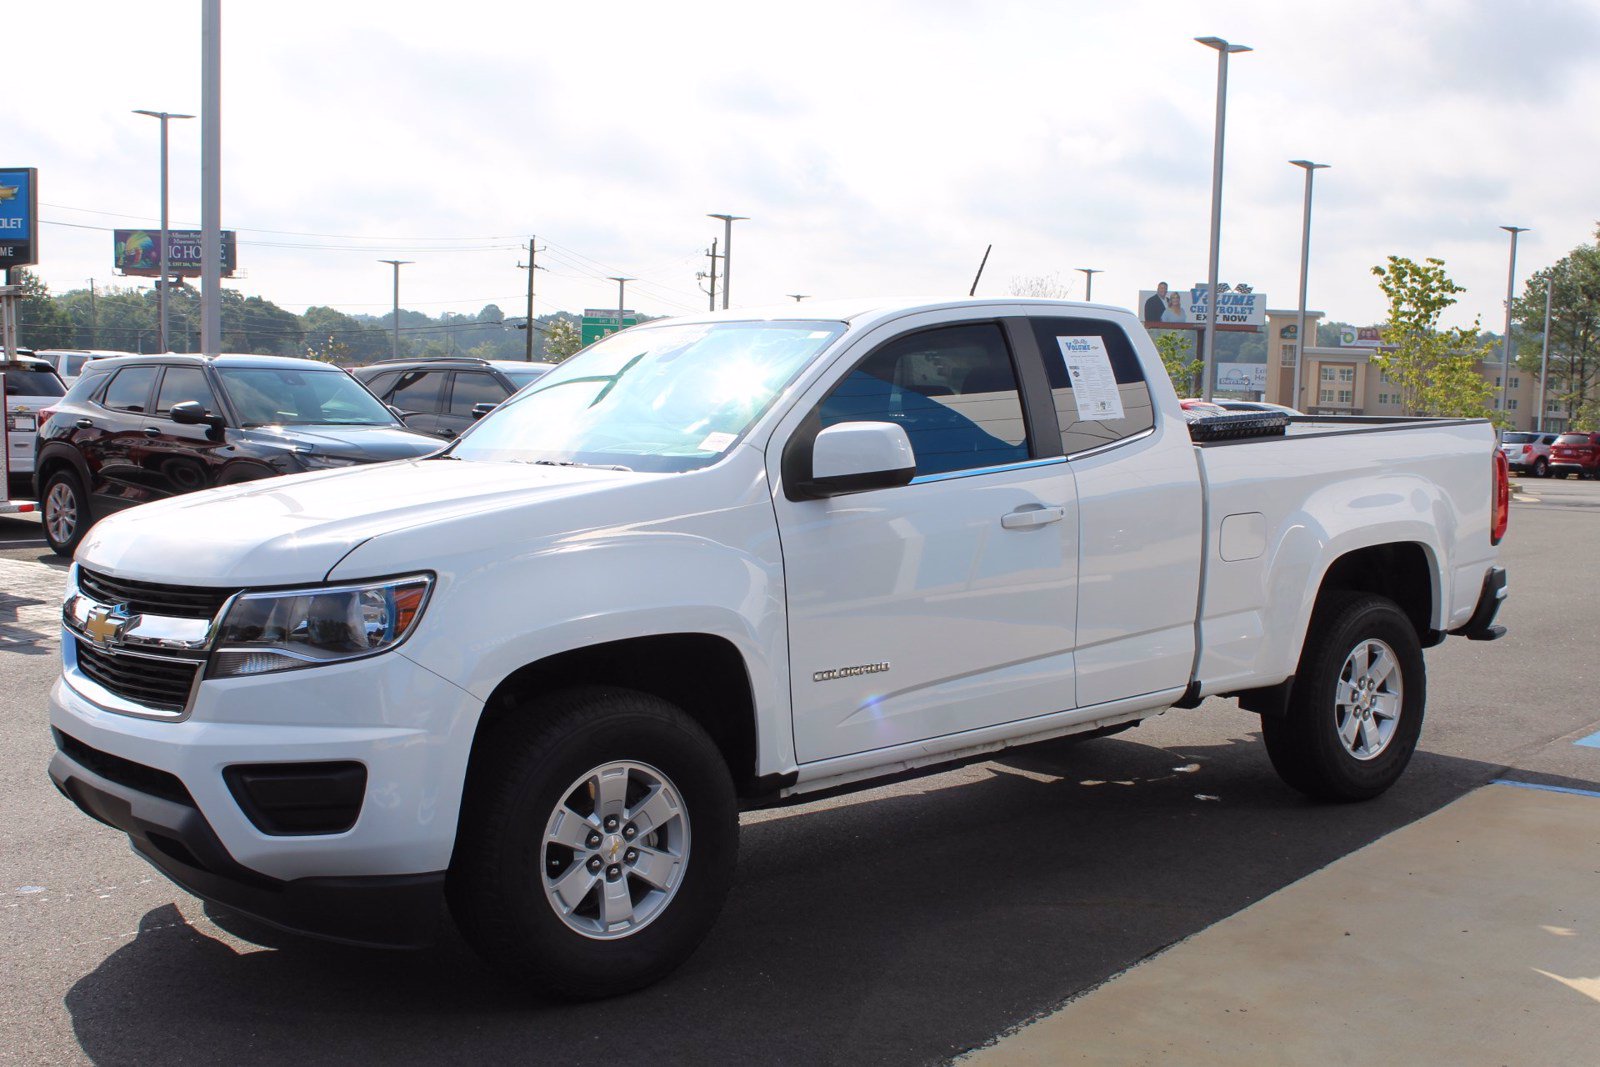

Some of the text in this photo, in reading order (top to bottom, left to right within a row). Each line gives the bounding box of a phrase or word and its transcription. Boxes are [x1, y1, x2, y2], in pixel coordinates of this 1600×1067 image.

[168, 245, 181, 258] IG
[1190, 305, 1254, 315] CHROLET
[1196, 313, 1248, 322] EXT NOW
[813, 662, 890, 682] COLORADO
